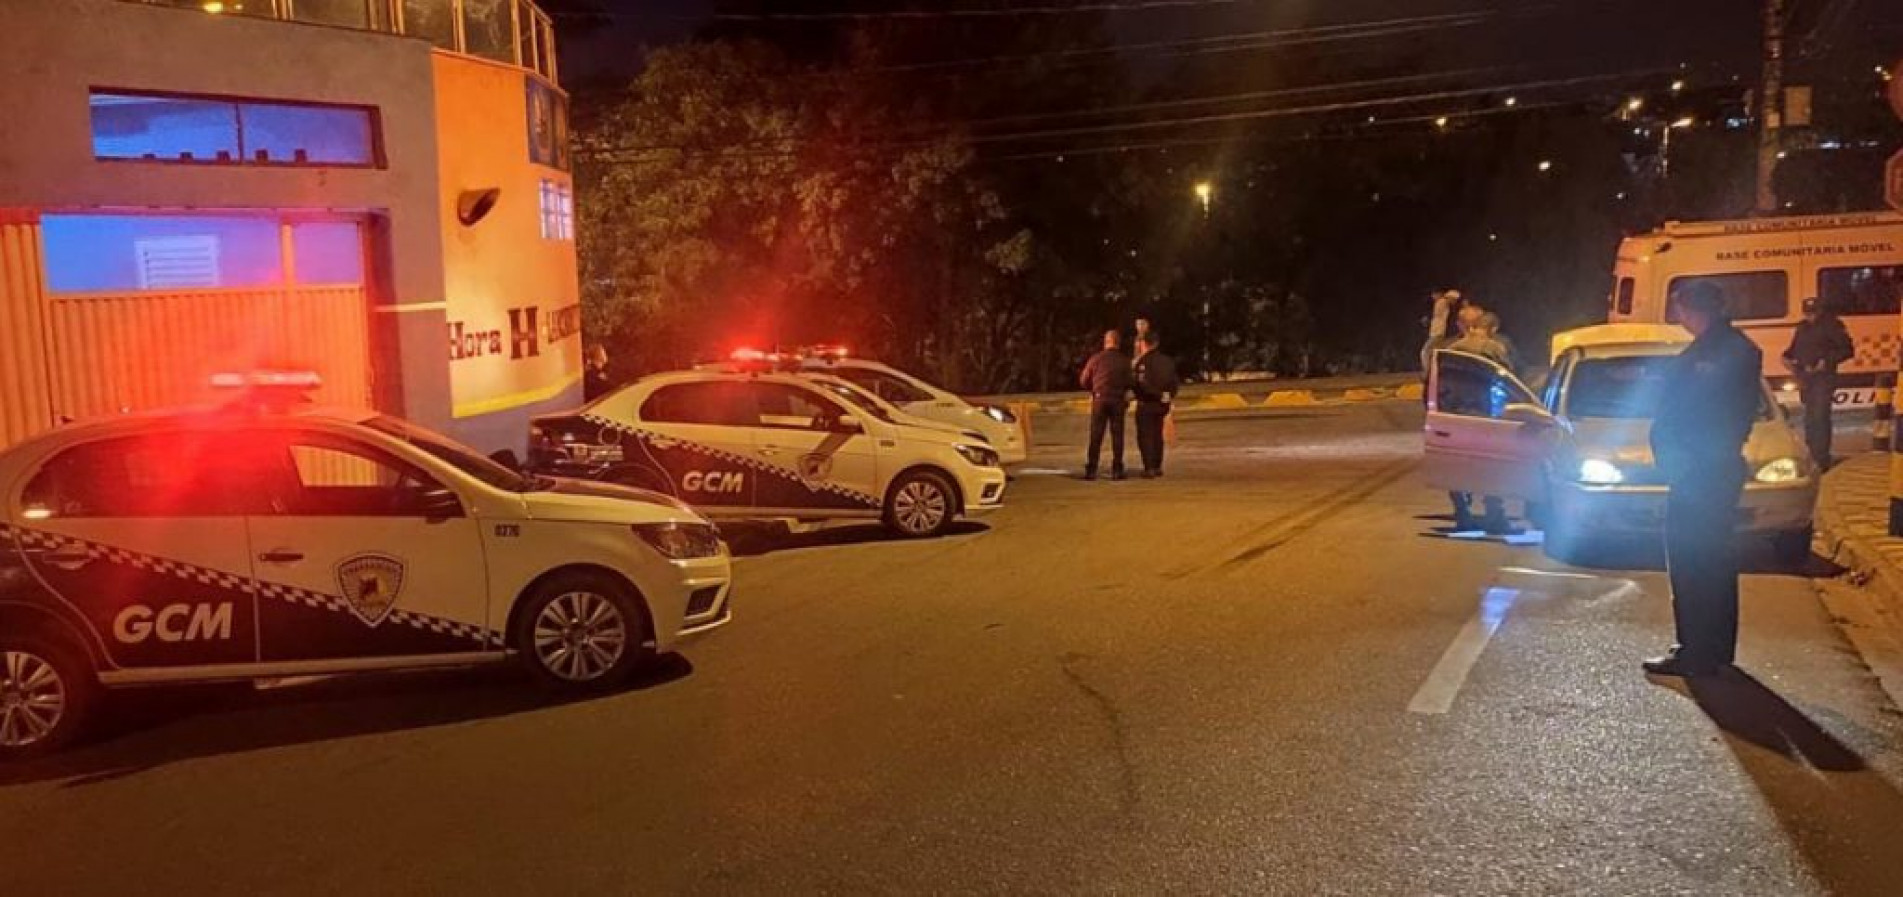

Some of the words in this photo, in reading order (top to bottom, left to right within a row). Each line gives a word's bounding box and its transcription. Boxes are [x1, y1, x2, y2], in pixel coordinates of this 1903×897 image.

[1716, 250, 1749, 261] BASE
[508, 306, 539, 360] H
[682, 470, 744, 493] GCM
[113, 602, 233, 643] GCM
